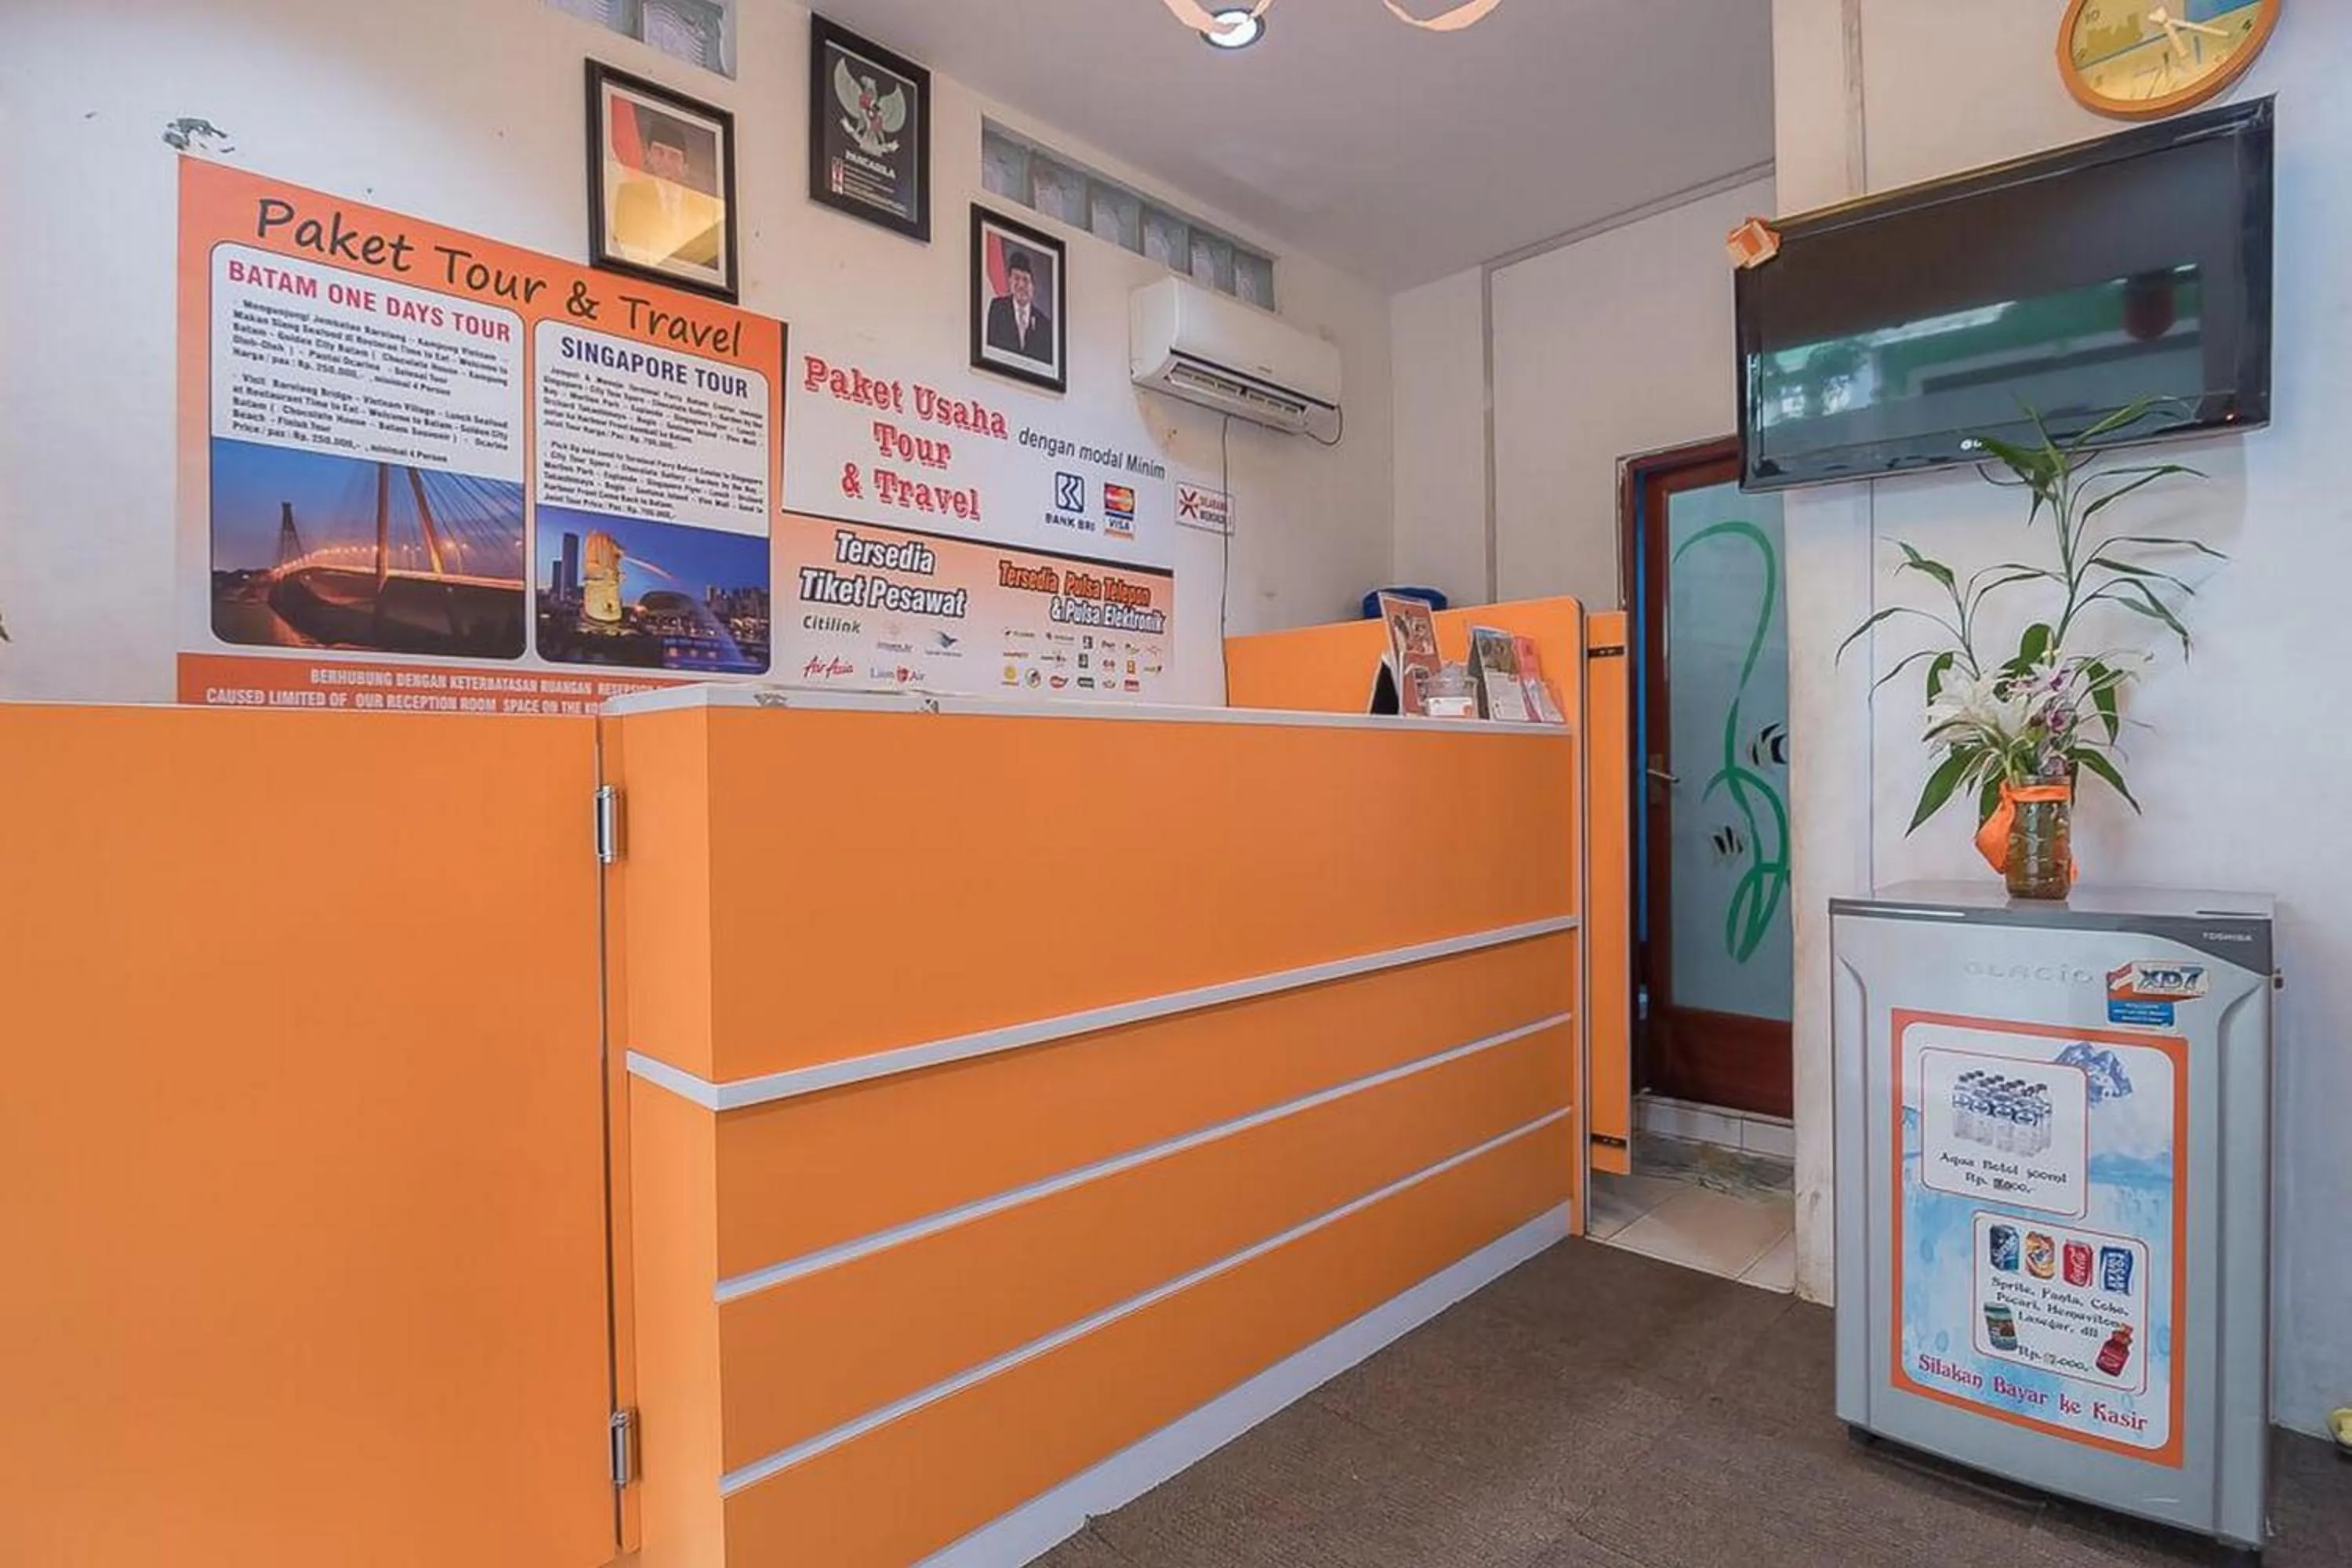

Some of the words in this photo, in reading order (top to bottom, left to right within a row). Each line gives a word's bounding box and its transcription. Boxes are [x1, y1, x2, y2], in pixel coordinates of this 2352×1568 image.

[257, 198, 413, 271] Paket
[434, 245, 546, 303] Tour
[565, 281, 599, 321] &
[619, 295, 741, 357] Travel
[229, 260, 318, 299] BATAM
[328, 284, 376, 313] ONE
[387, 296, 444, 328] DAYS
[452, 312, 510, 342] TOUR
[561, 336, 687, 384] SINGAPORE
[695, 368, 748, 398] TOUR
[804, 355, 902, 413] Paket
[913, 384, 1008, 439] Usaha
[873, 422, 951, 468] Tour
[1019, 427, 1075, 457] dengan
[1080, 445, 1123, 470] modal
[1127, 455, 1165, 479] Minim
[842, 463, 863, 499] &
[873, 469, 980, 521] Travel
[1046, 513, 1075, 528] BANK
[1078, 520, 1095, 532] BRI
[1108, 518, 1130, 530] VISA
[836, 529, 935, 575] Tersedia
[800, 567, 867, 607] Tiket
[867, 575, 967, 617] Pesawat
[1000, 560, 1059, 594] Tersedia
[1065, 570, 1101, 601] Pulsa
[1051, 597, 1062, 622] &
[1064, 598, 1101, 626] Pulsa
[1104, 603, 1166, 633] Elektronik
[207, 688, 263, 704] CAUSED
[269, 690, 325, 706] LIMITED
[329, 691, 347, 706] OF
[356, 693, 383, 708] OUR
[387, 694, 456, 710] RECEPTION
[460, 697, 495, 712] ROOM
[503, 699, 540, 713] SPACE
[561, 702, 582, 714] THE
[310, 669, 392, 686] BERHUBUNG
[397, 673, 447, 689] DENGAN
[2202, 932, 2252, 942] TOSHIBA
[1940, 1152, 1974, 1167] Aqua
[1991, 1276, 2035, 1295] Sprite,
[2042, 1287, 2084, 1307] Fanta,
[1919, 1354, 1984, 1390] Silakan
[1994, 1376, 2049, 1406] Bayar
[2060, 1392, 2082, 1416] ke
[2092, 1401, 2149, 1432] Kasir
